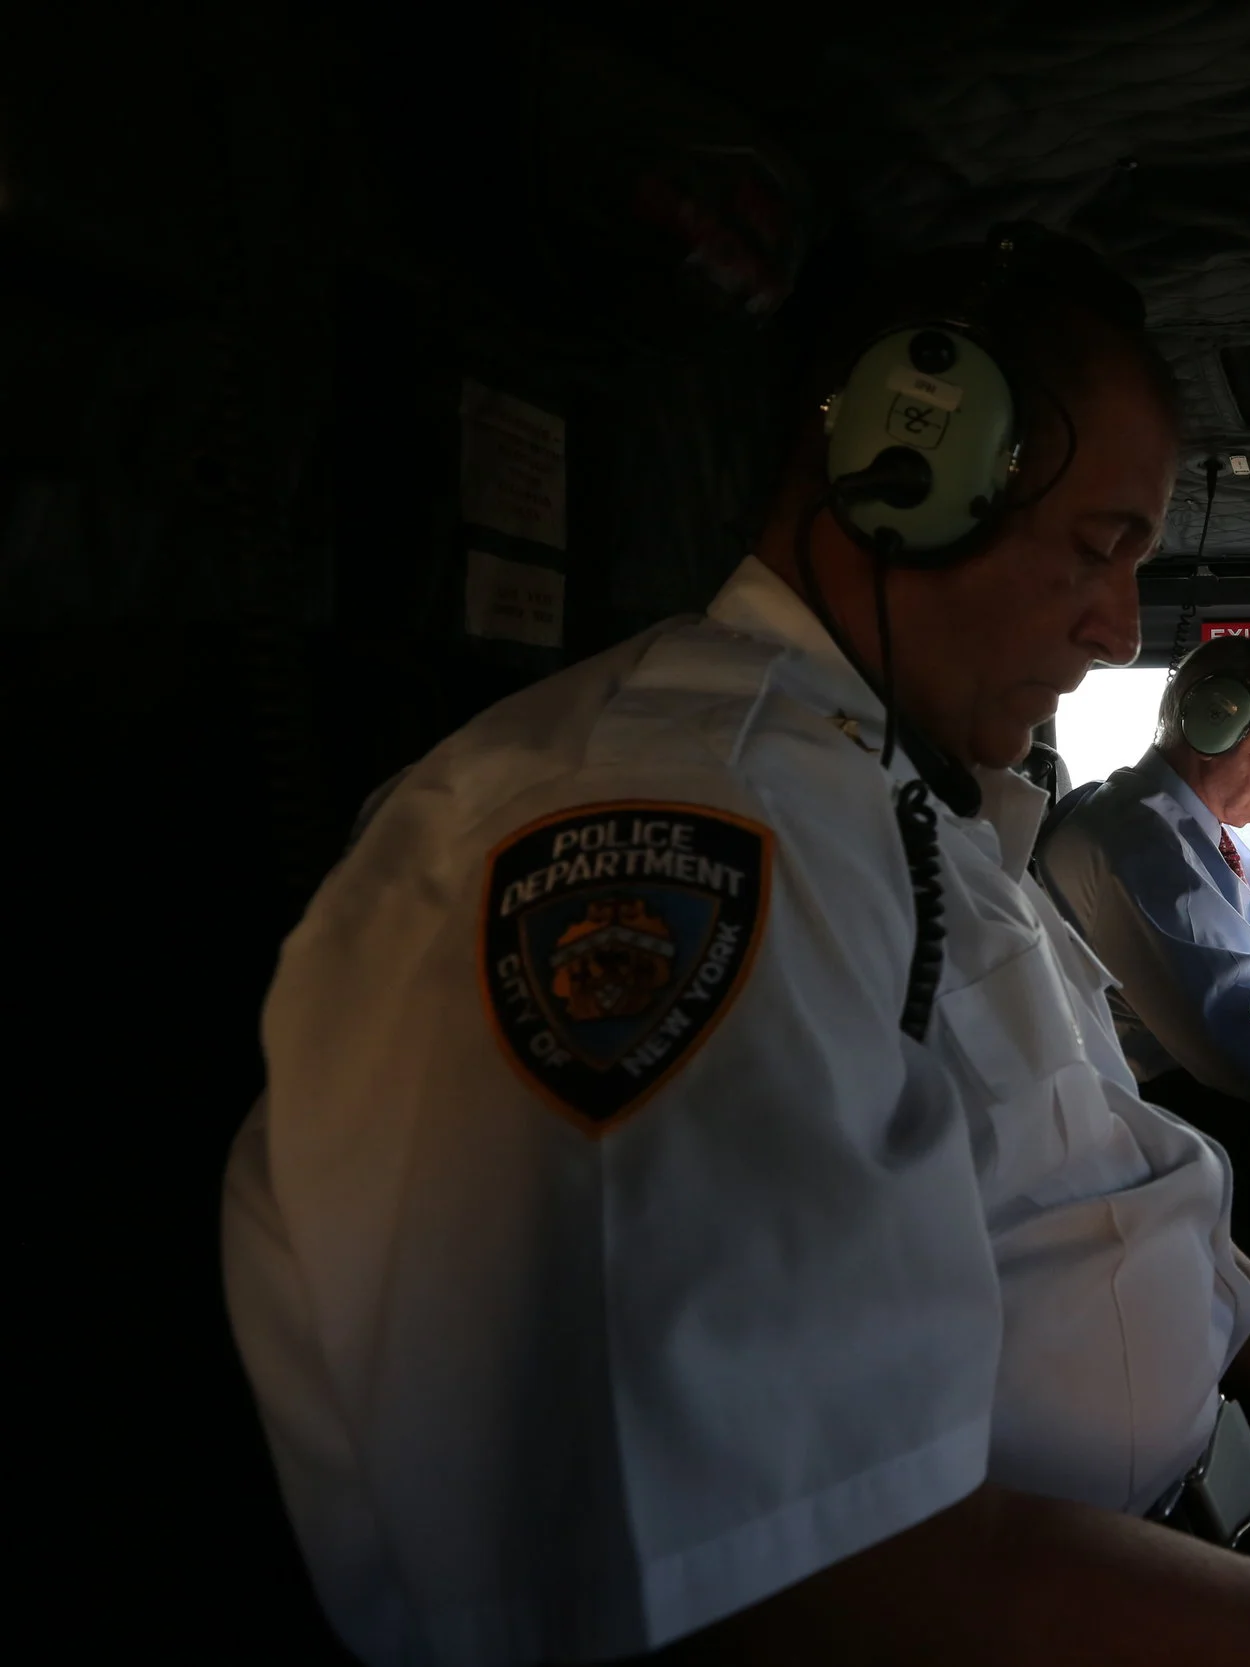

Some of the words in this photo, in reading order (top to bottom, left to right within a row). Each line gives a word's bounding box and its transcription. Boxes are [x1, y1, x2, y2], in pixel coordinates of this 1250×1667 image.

[551, 820, 695, 860] POLICE
[498, 849, 746, 917] DEPARTMENT
[496, 952, 537, 1026] CITY
[528, 1028, 573, 1069] OF
[620, 1007, 694, 1079] NEW
[683, 921, 744, 1002] YORK
